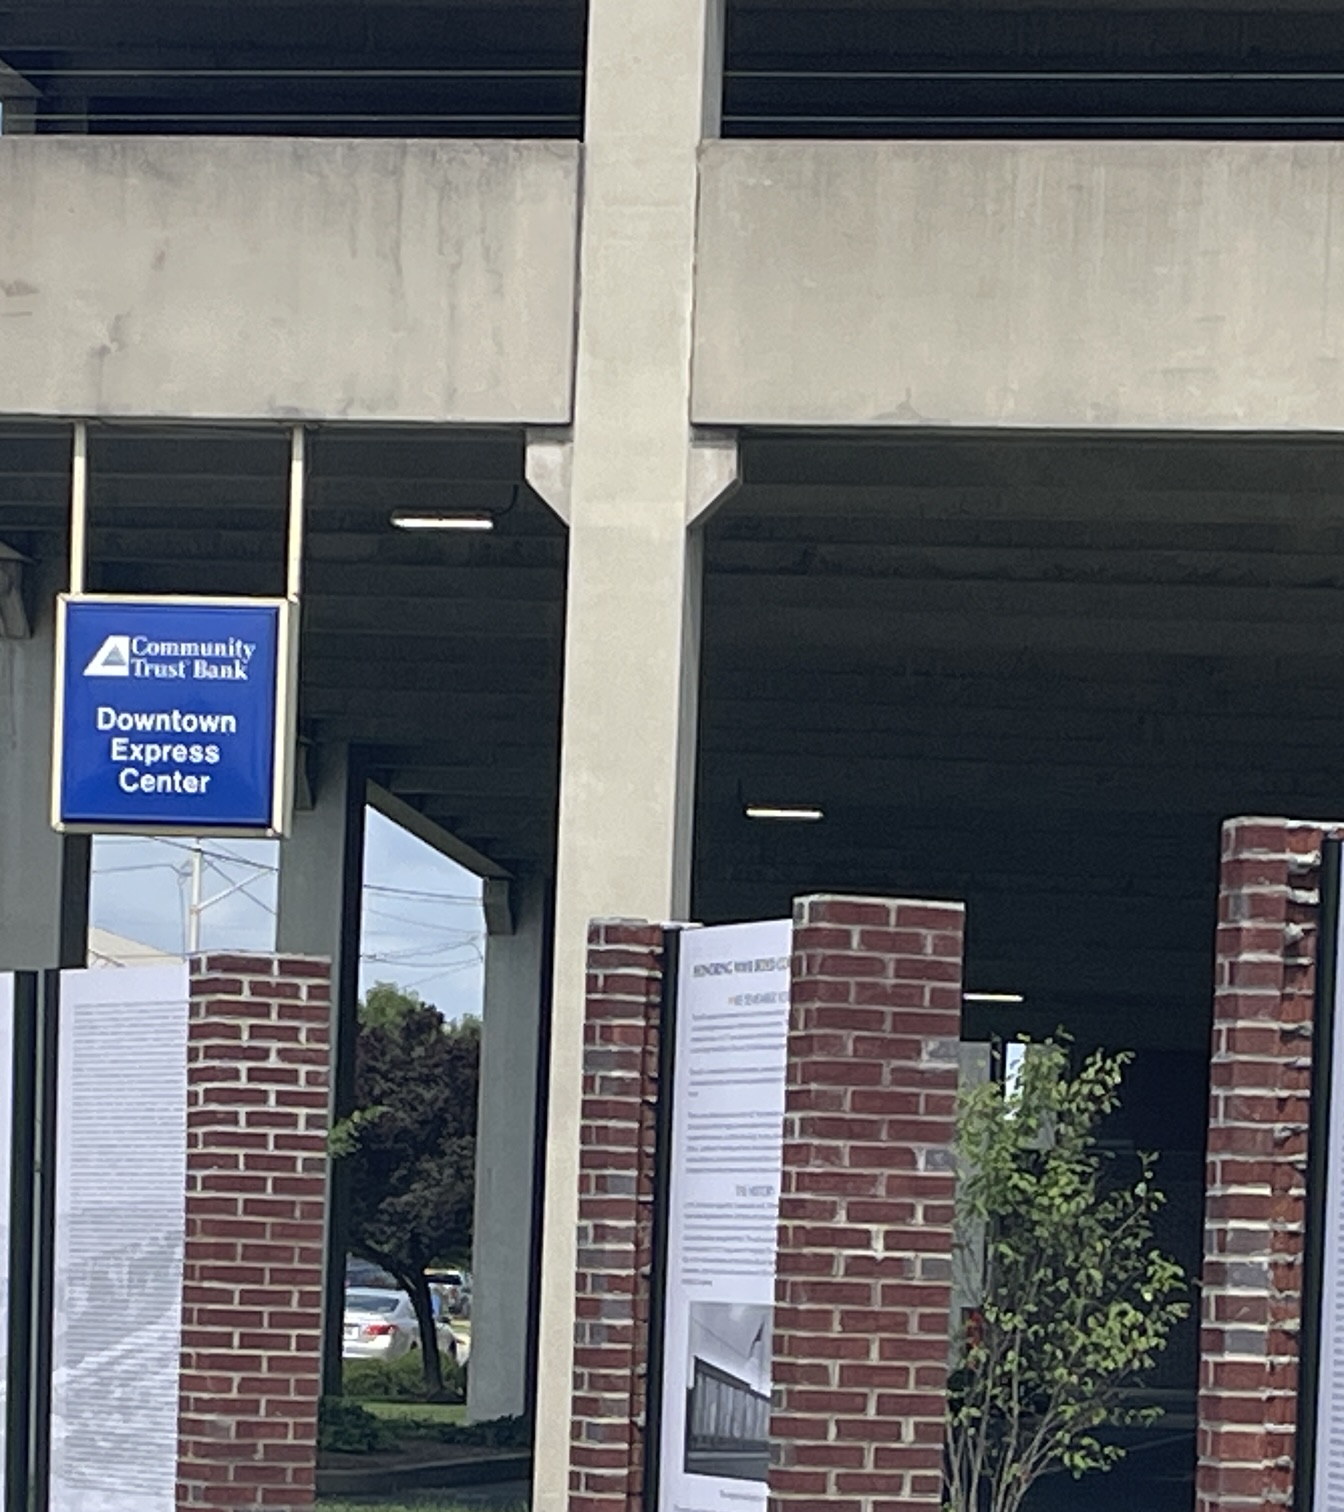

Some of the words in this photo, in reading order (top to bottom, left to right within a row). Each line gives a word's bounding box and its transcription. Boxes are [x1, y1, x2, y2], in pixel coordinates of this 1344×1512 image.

[131, 635, 256, 662] Community
[131, 658, 187, 679] Trust
[193, 660, 248, 681] Bank
[96, 706, 237, 733] Downtown
[111, 737, 220, 766] Express
[119, 767, 211, 793] Center
